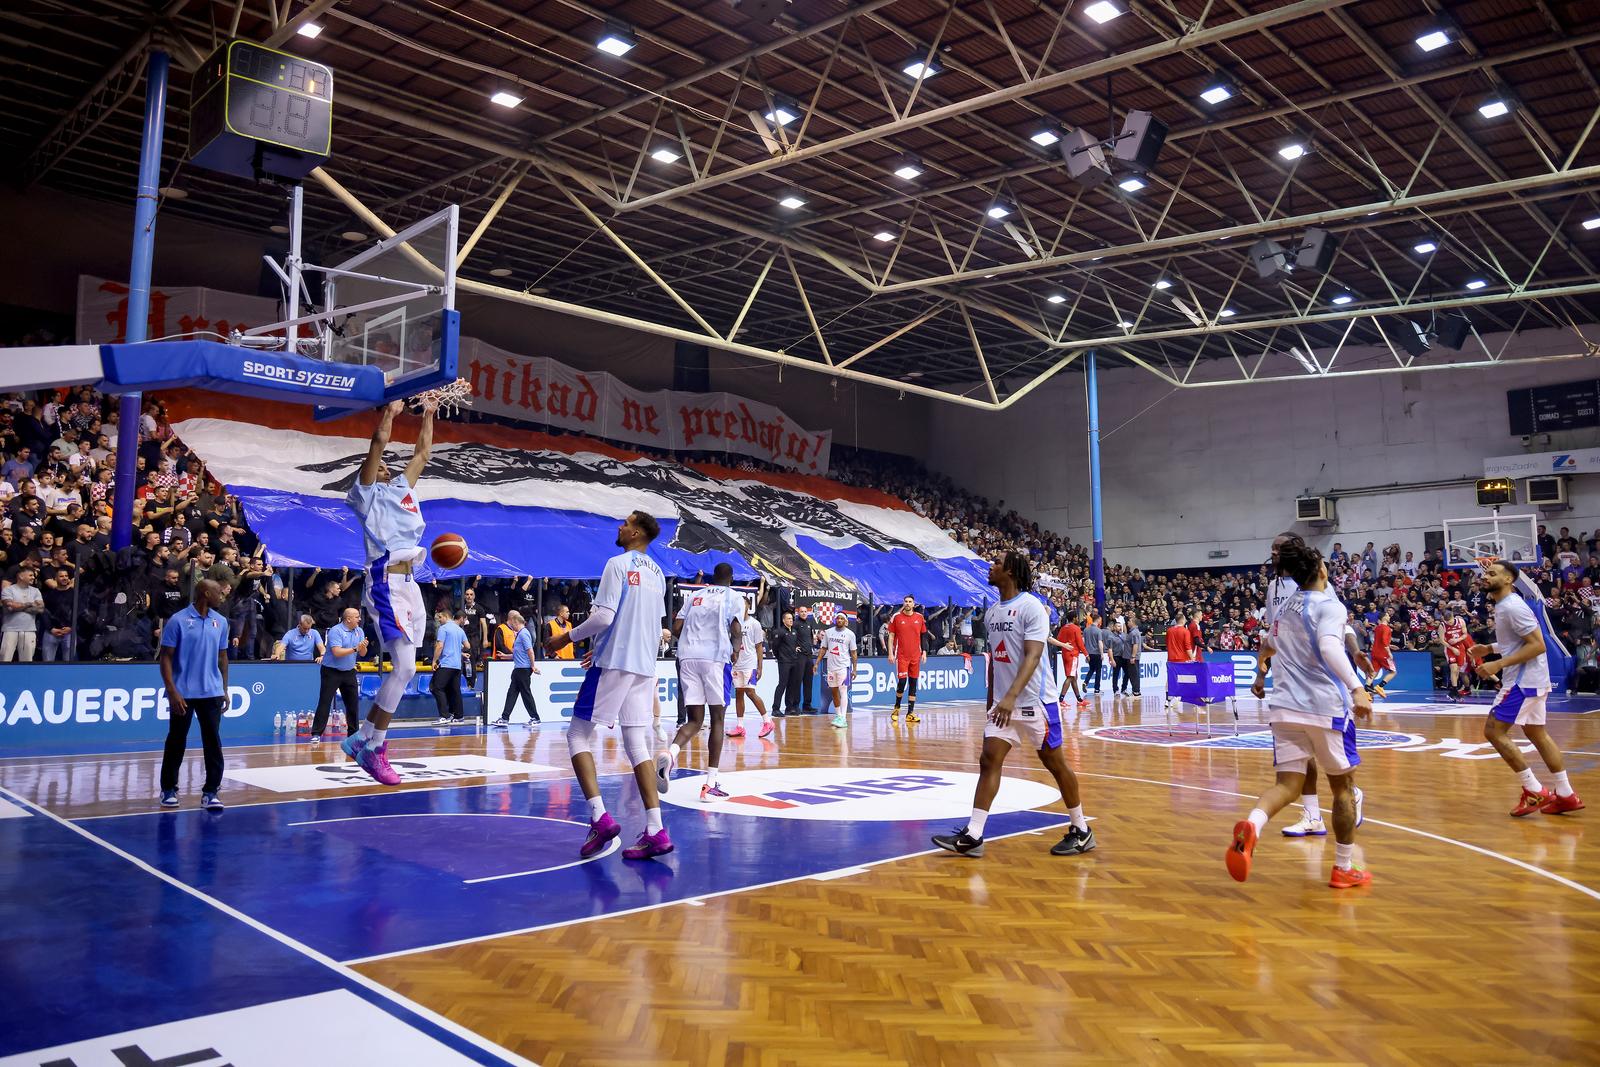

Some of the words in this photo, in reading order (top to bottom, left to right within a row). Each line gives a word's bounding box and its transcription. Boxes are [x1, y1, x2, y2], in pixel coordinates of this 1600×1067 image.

[243, 361, 293, 380] SPORT
[296, 370, 356, 388] SYSTEM
[469, 357, 599, 422] nikad
[621, 397, 661, 436] ne
[1211, 674, 1232, 683] molten
